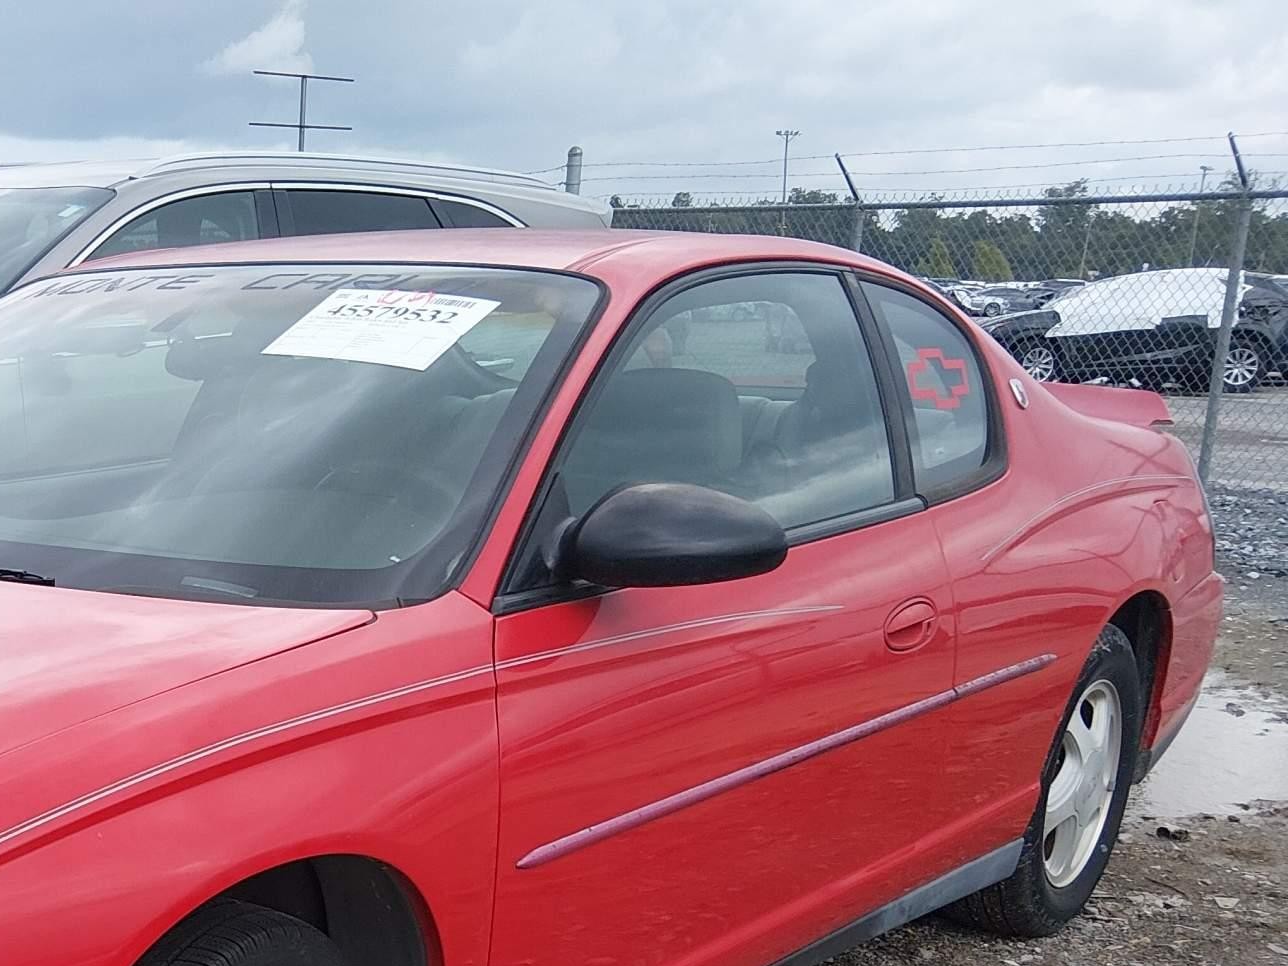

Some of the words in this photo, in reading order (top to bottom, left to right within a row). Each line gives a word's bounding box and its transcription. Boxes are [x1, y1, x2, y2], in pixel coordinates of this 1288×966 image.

[24, 274, 215, 298] MONTE
[239, 273, 419, 290] CARL
[327, 303, 459, 324] 45579532
